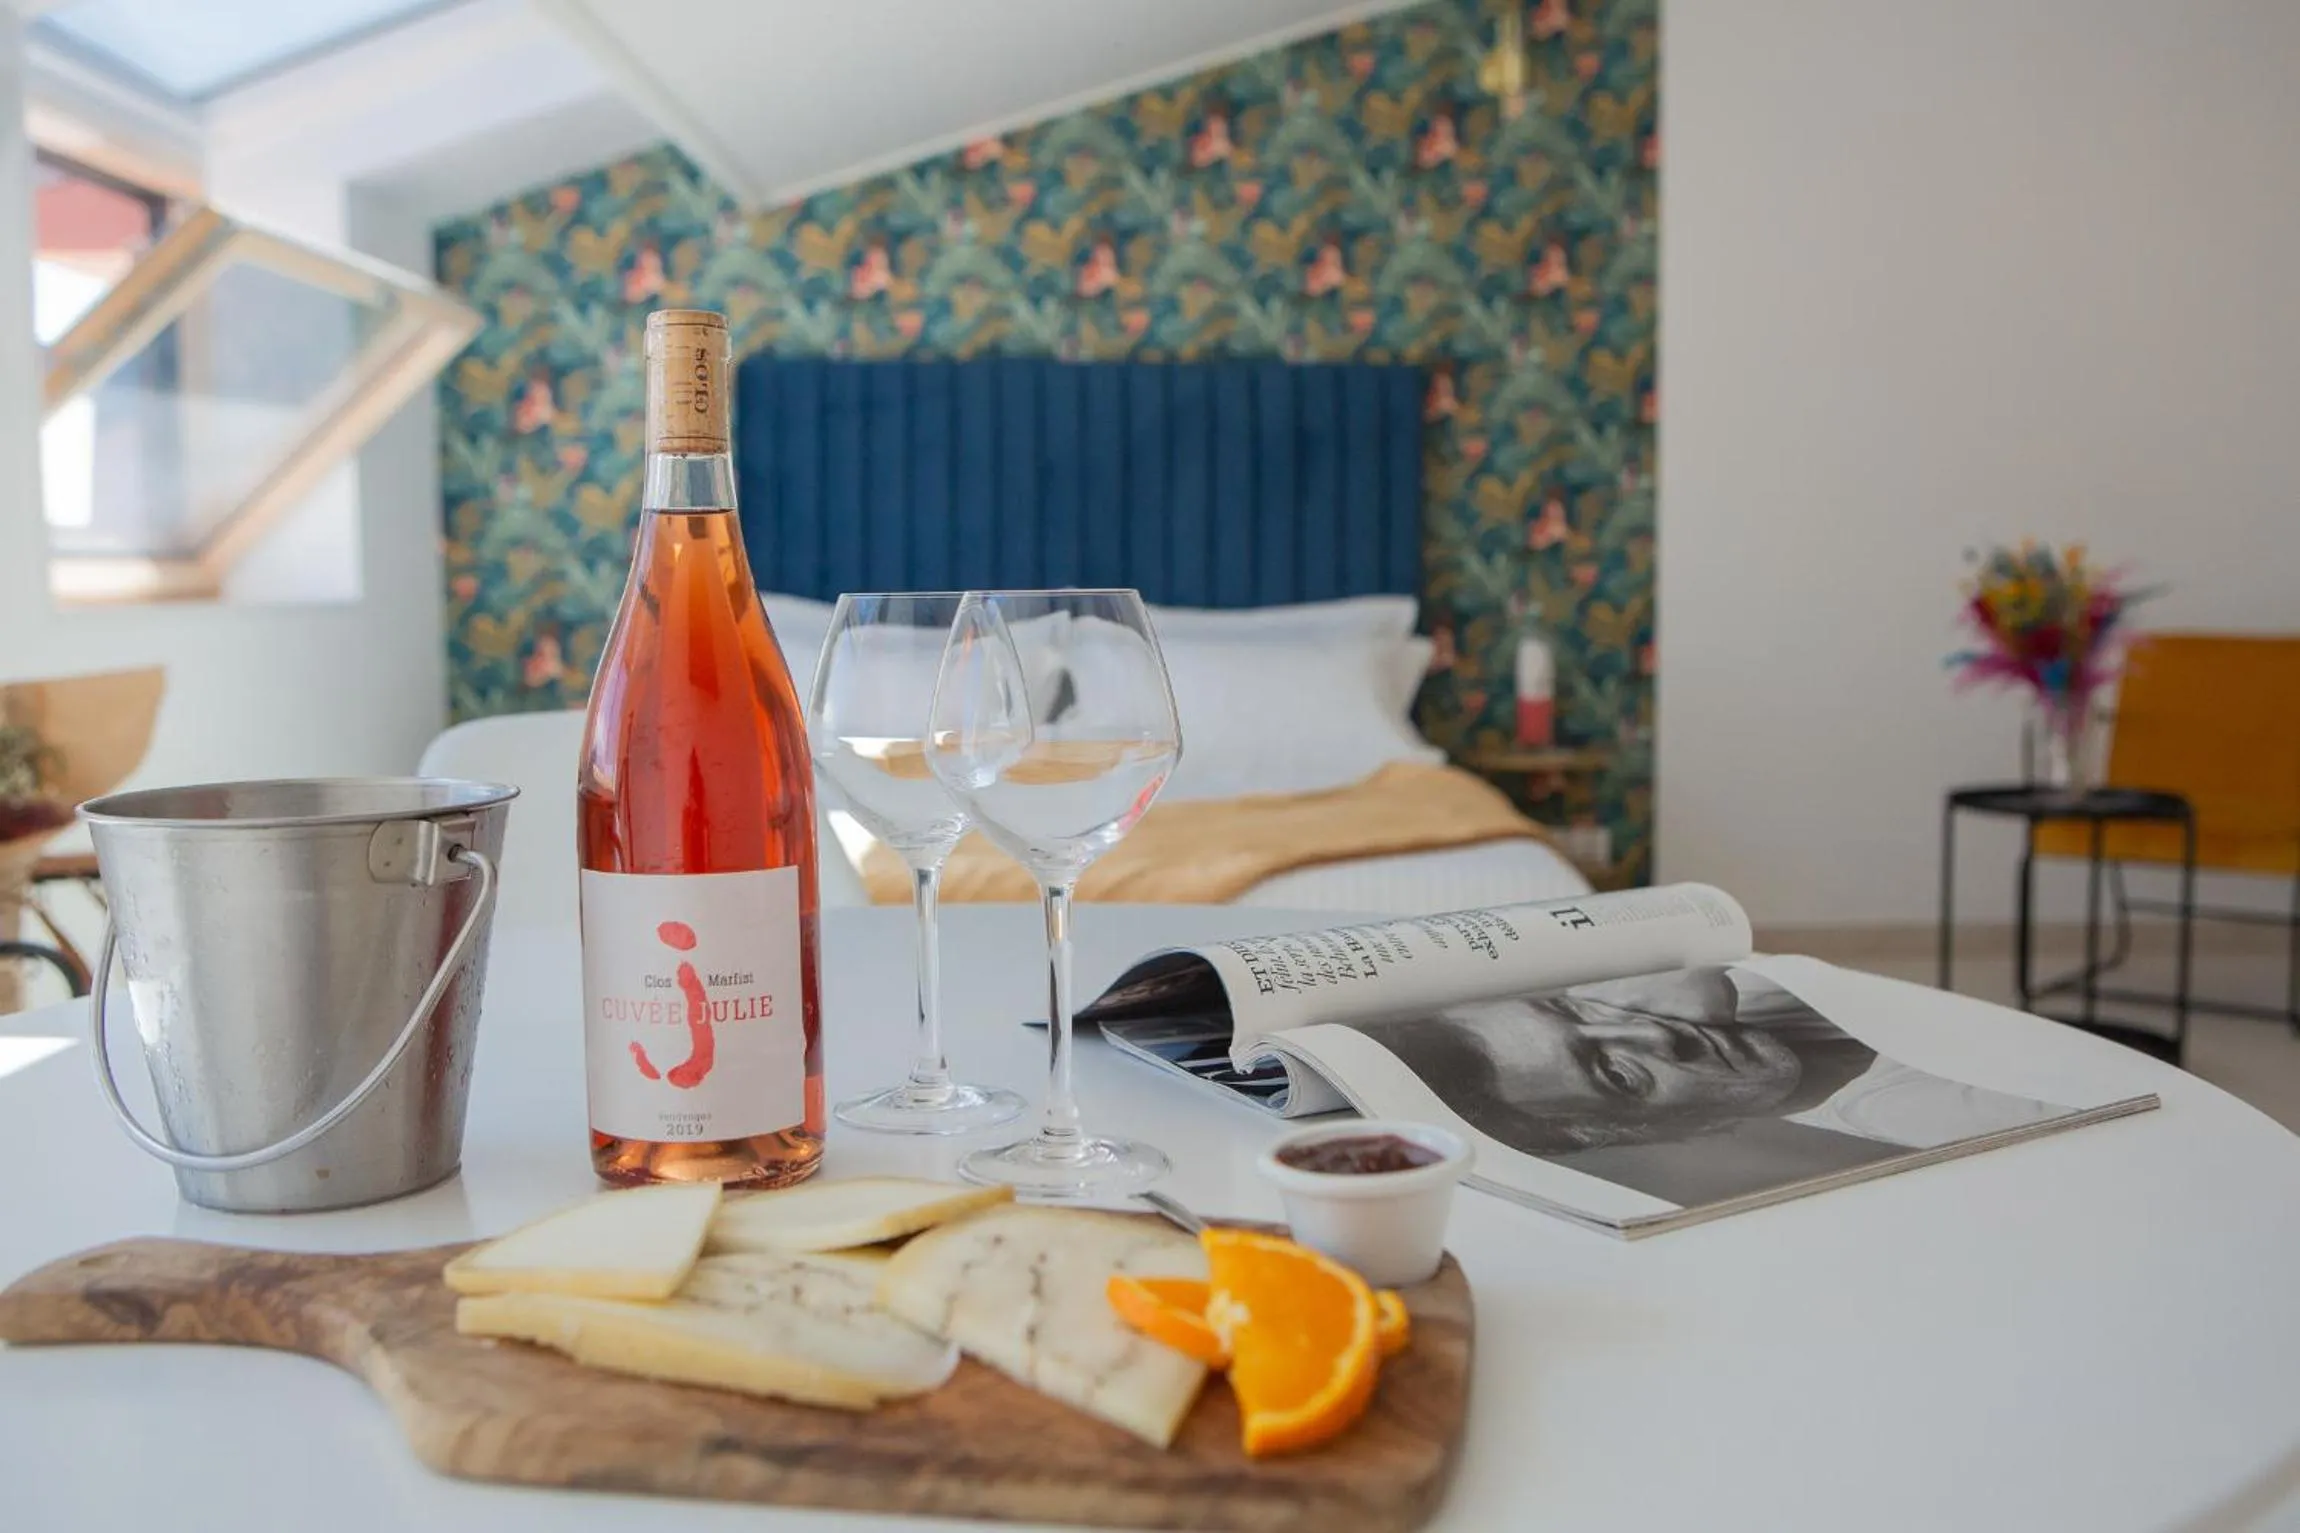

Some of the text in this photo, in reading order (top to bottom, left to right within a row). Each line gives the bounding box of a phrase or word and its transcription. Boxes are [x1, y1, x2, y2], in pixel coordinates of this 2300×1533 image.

[694, 347, 708, 413] CLOS
[1550, 906, 1595, 930] il
[1361, 955, 1378, 978] La
[643, 974, 673, 989] Clos
[1250, 966, 1275, 995] ET
[601, 994, 774, 1026] CUVÉE JULIE
[665, 1123, 704, 1137] 2019
